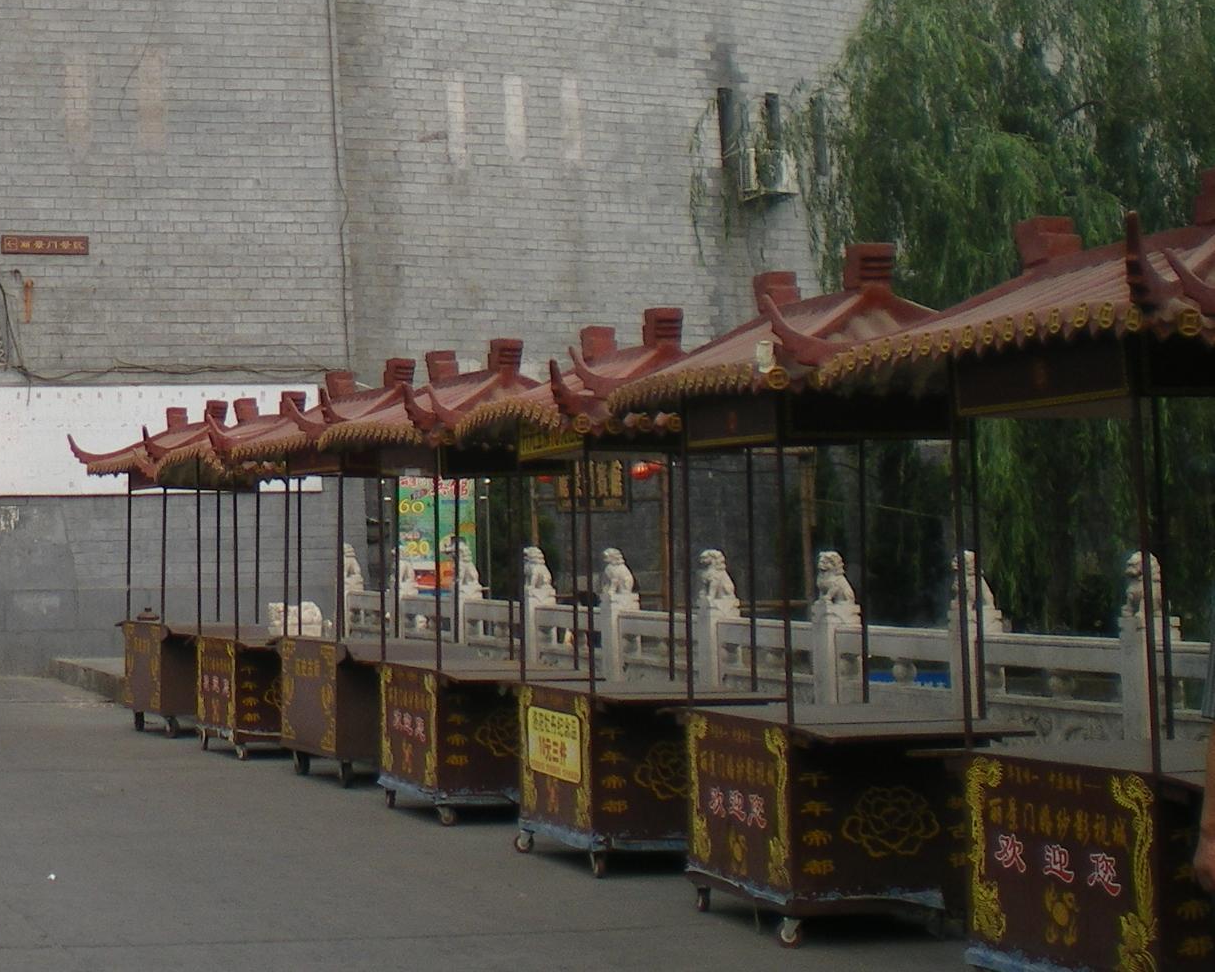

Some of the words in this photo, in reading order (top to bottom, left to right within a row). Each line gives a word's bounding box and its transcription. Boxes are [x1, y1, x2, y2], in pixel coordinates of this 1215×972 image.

[708, 786, 768, 829] 欢迎您
[993, 832, 1122, 897] 欢迎您
